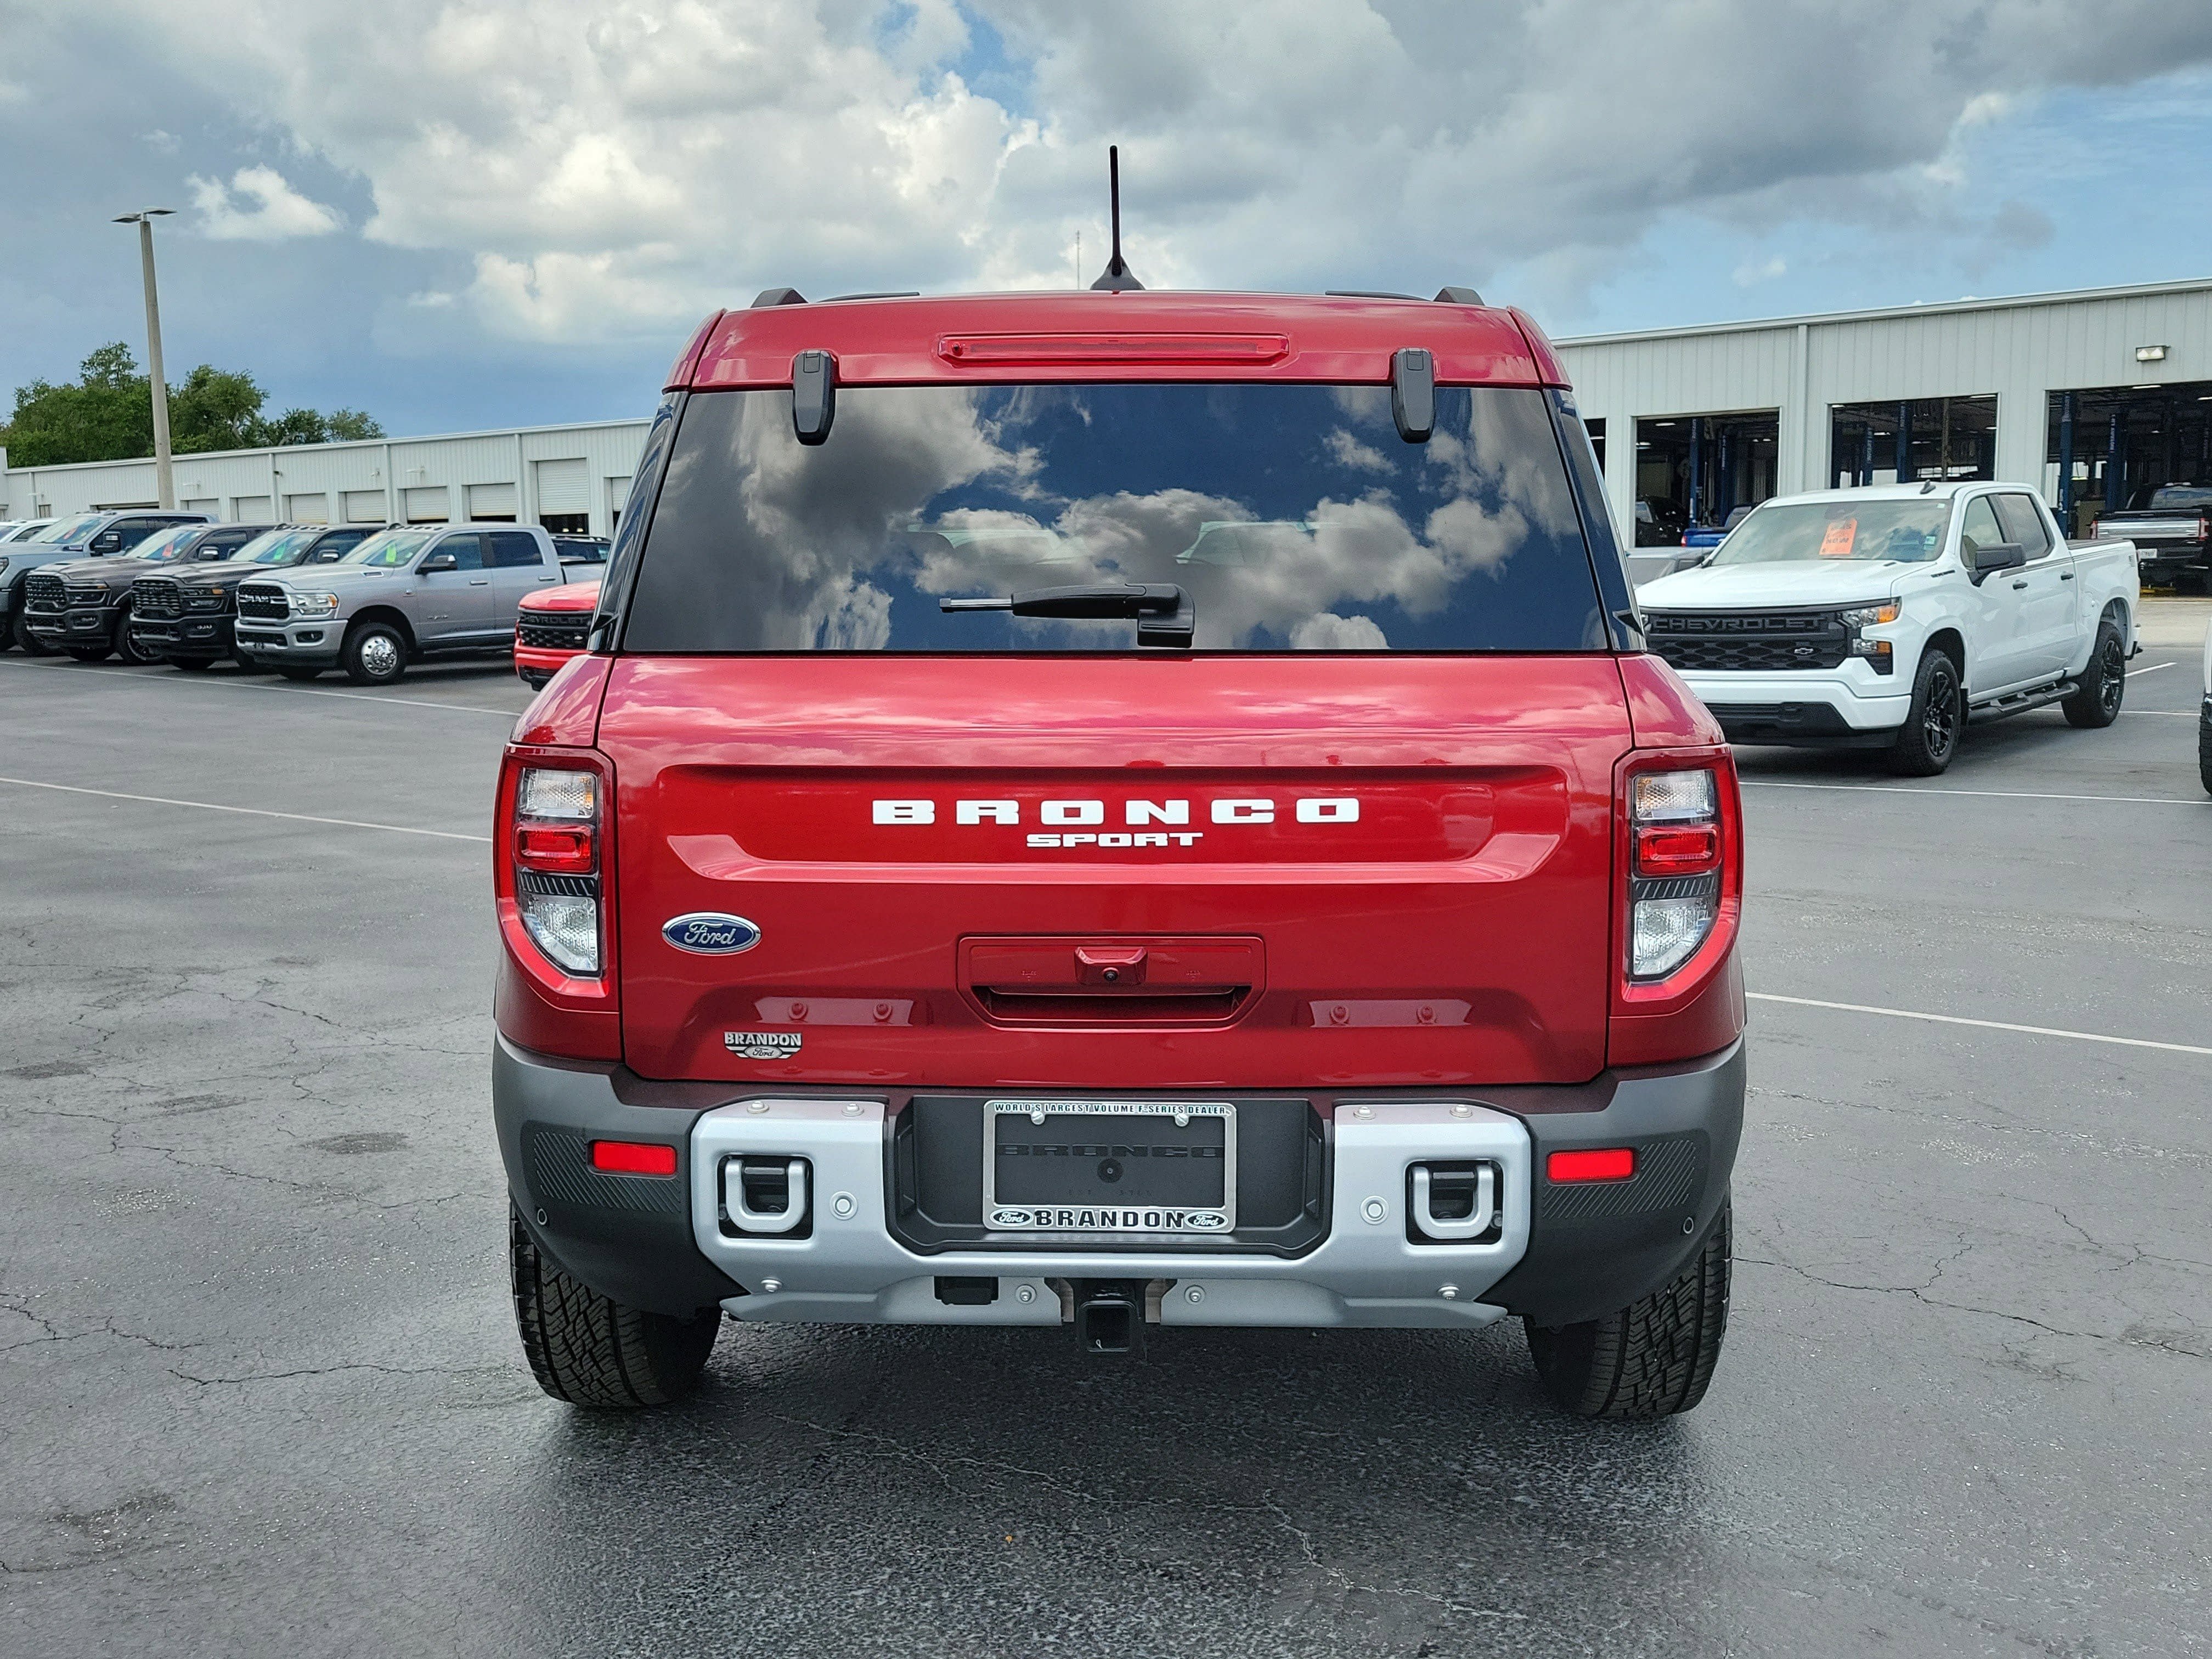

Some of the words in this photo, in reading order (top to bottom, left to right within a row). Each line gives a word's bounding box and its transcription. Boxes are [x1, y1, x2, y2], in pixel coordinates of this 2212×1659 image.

[1653, 617, 1827, 630] CHEVROLET
[872, 797, 1359, 825] BRONCO
[1026, 832, 1203, 848] SPORT
[684, 921, 736, 944] Ford
[724, 1031, 802, 1046] BRANDON
[752, 1047, 774, 1057] Ford
[995, 1103, 1041, 1111] WORLD'S
[1045, 1104, 1090, 1112] LARGEST
[1093, 1104, 1135, 1113] VOLUME
[1188, 1106, 1225, 1114] DEALER
[996, 1143, 1223, 1156] BRONCO
[998, 1211, 1024, 1223] Ford
[1034, 1209, 1185, 1228] BRANDON
[1193, 1214, 1220, 1226] Ford
